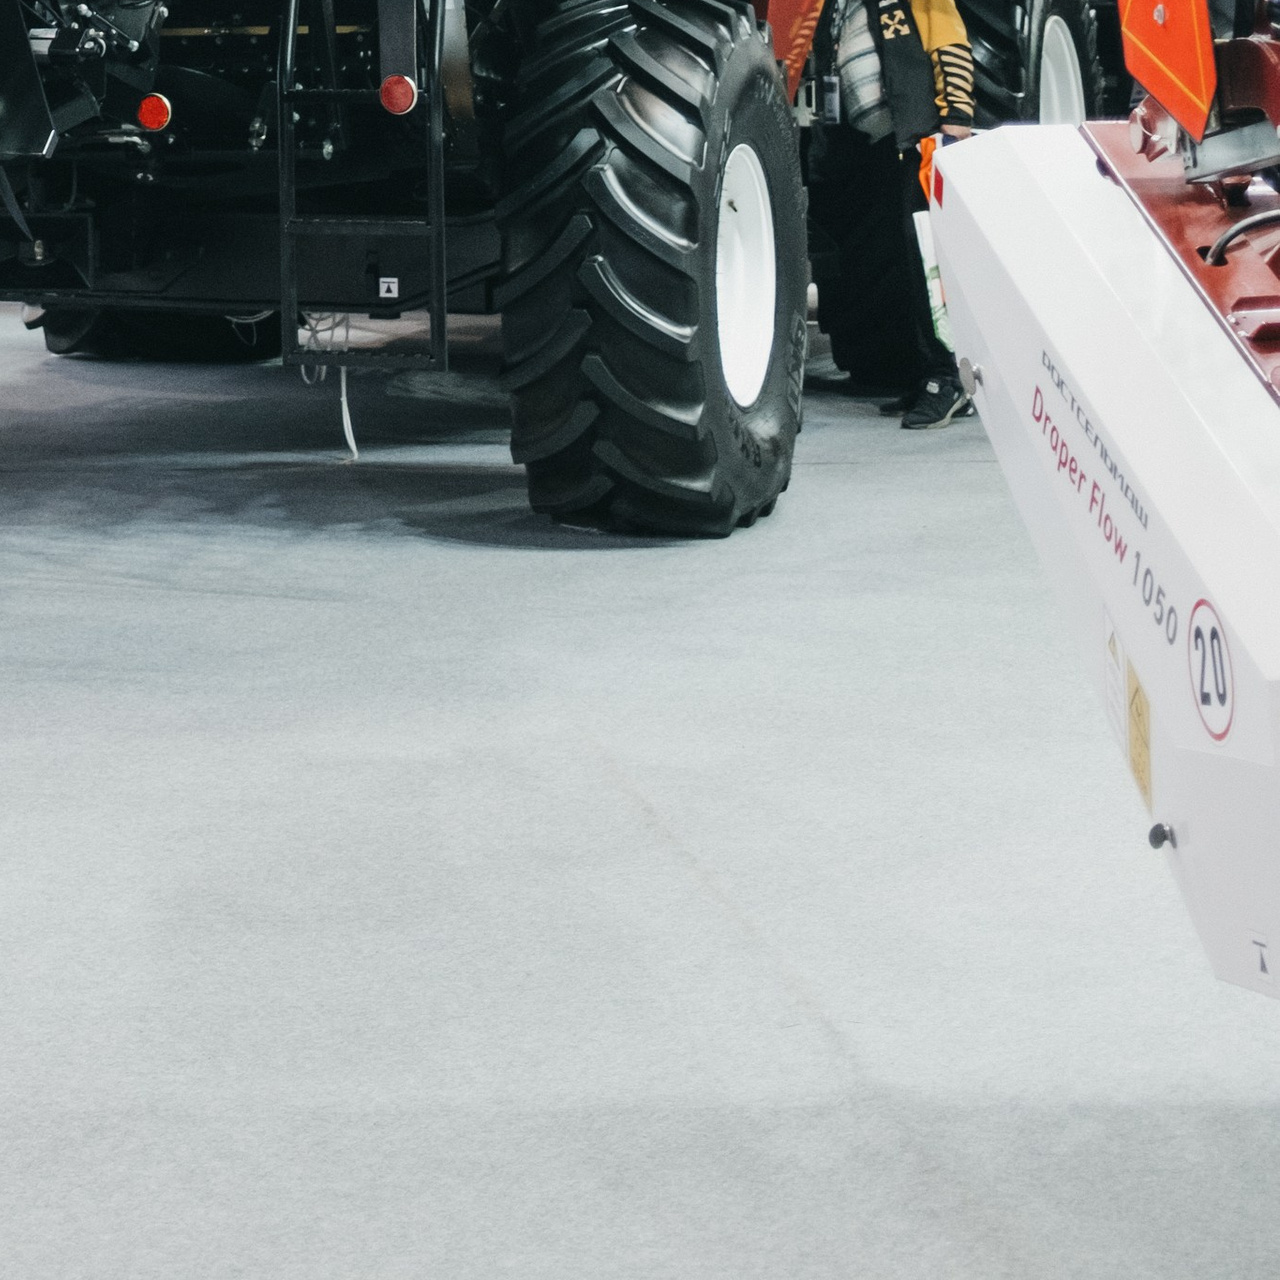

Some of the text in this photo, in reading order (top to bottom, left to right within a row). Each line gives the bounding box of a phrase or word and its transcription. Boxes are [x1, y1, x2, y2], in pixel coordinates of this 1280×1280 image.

[1032, 384, 1178, 646] Draper Flow 1050
[1042, 349, 1149, 531] РОСТСЕЛЬМАШ
[1194, 625, 1227, 707] 20
